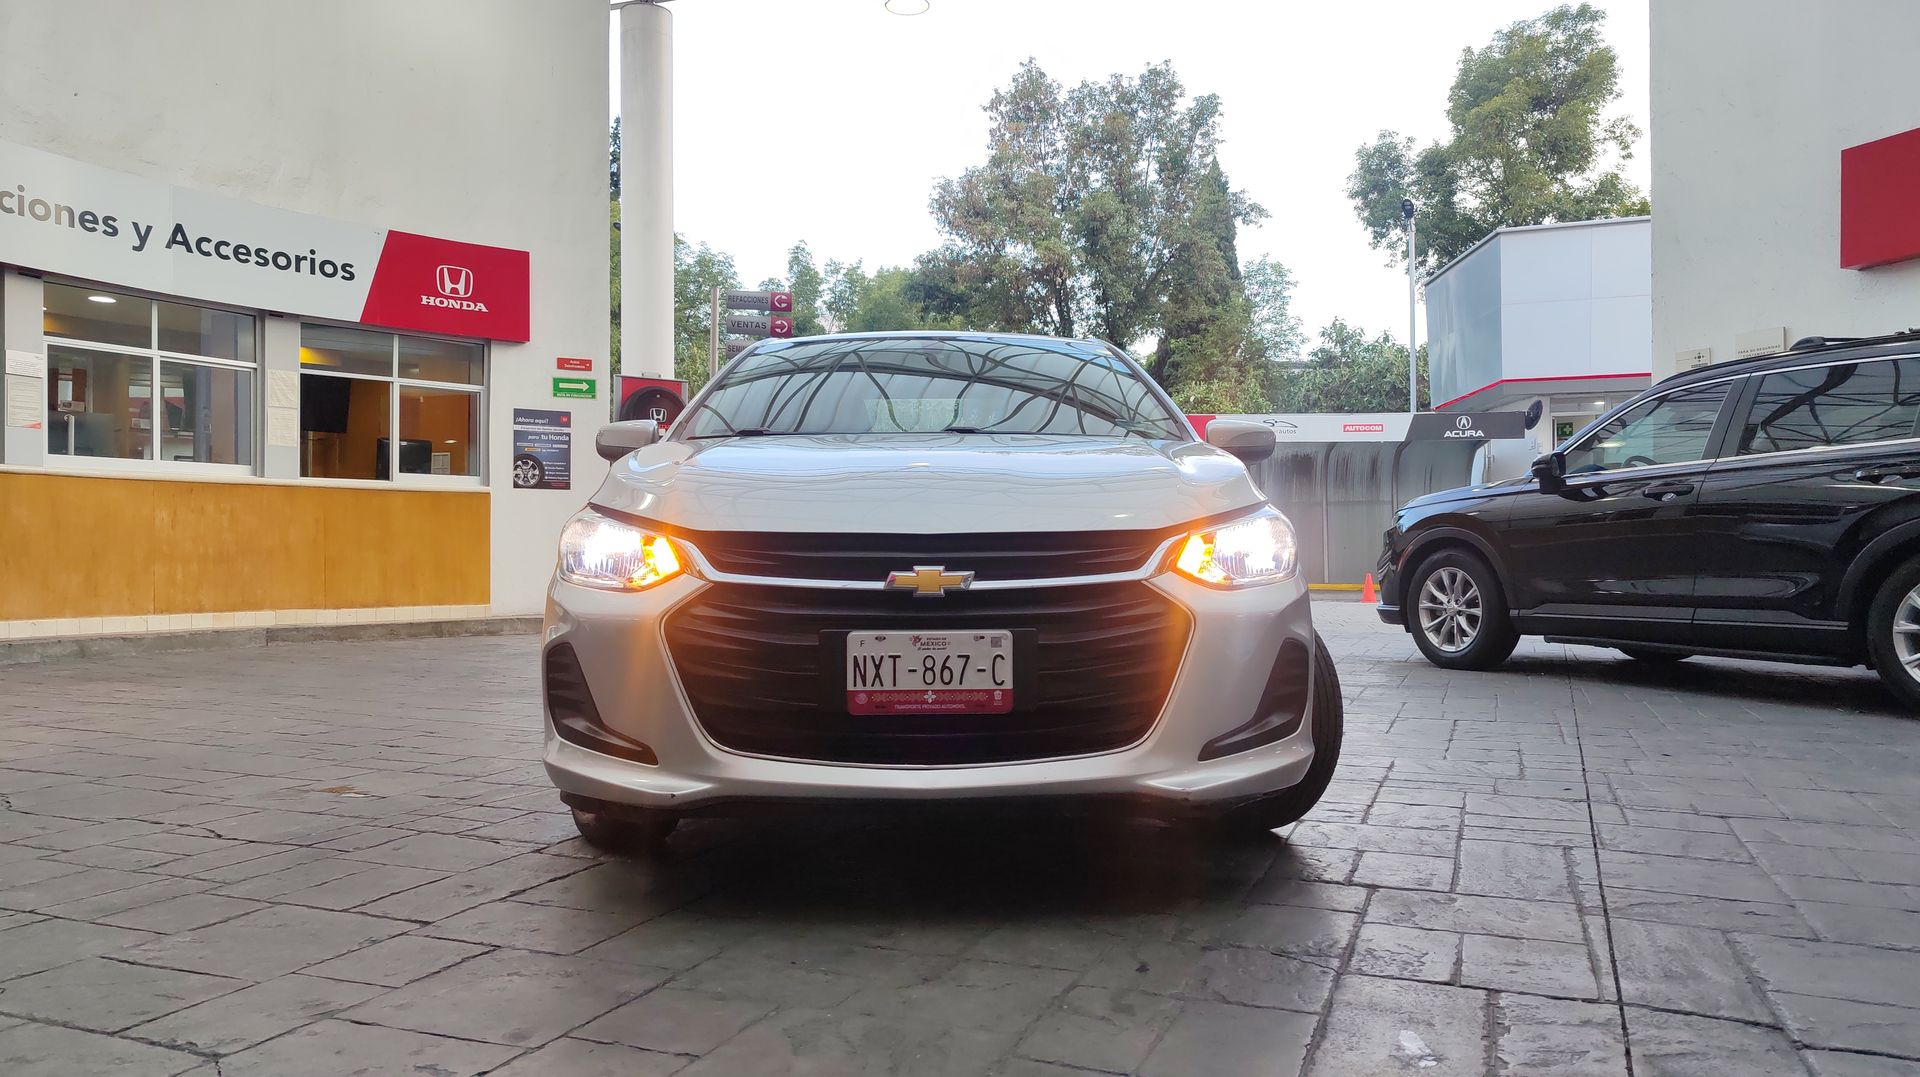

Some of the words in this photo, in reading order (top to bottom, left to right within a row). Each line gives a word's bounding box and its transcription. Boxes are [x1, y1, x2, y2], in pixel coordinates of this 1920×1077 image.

[132, 221, 153, 252] y
[165, 222, 356, 282] Accesorios
[420, 295, 489, 312] HONDA
[728, 295, 769, 304] REFACCIONES
[731, 320, 767, 329] VENTAS
[1443, 430, 1485, 438] ACURA
[853, 654, 1005, 687] NXT-867-C
